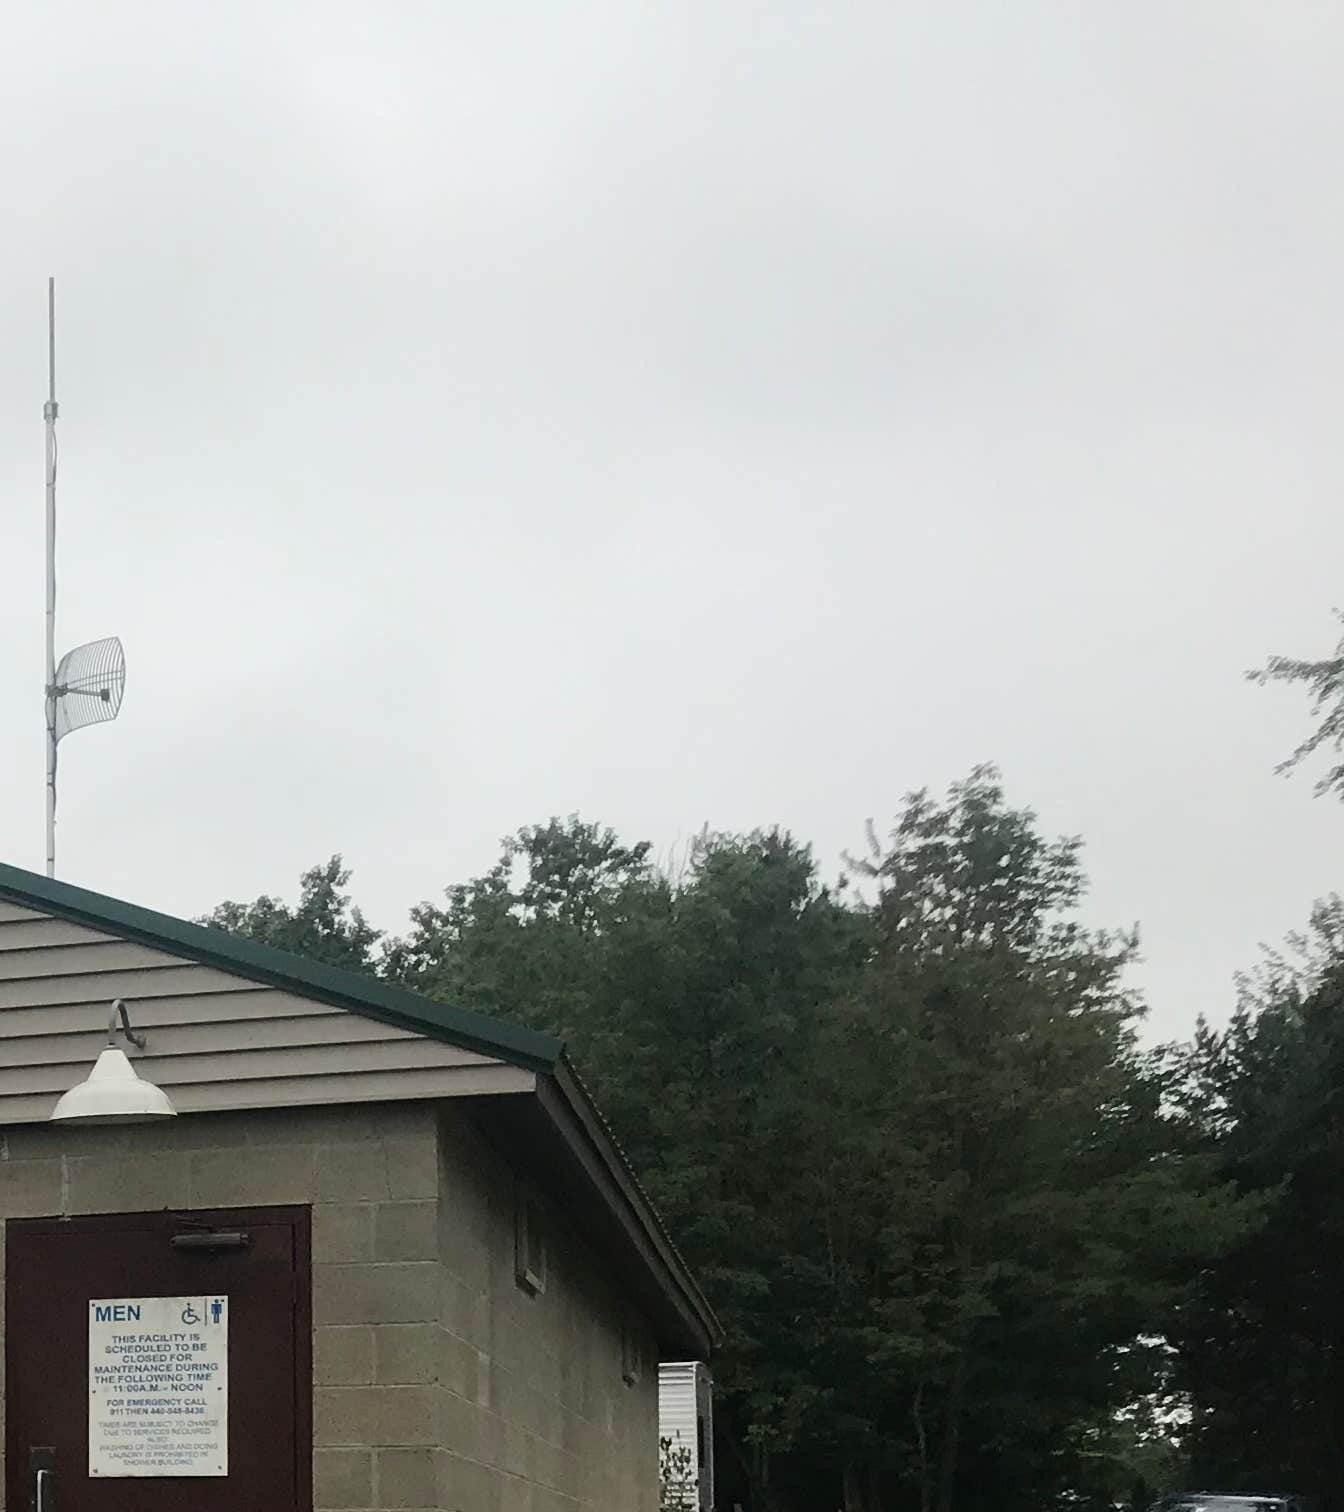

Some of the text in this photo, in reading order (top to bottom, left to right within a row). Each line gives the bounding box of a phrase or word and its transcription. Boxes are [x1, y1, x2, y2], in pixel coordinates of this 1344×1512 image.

[95, 1305, 141, 1322] MEN
[112, 1333, 200, 1344] THIS FACILITY IS
[105, 1342, 208, 1354] SCHEDULED TO BE
[122, 1353, 193, 1363] CLOSED FOR
[94, 1362, 219, 1374] MAINTENANCE DURING
[95, 1372, 212, 1384] THE FOLLOWING TIME
[171, 1383, 203, 1392] NOON
[106, 1398, 208, 1407] FOR EMERGENCY CALL
